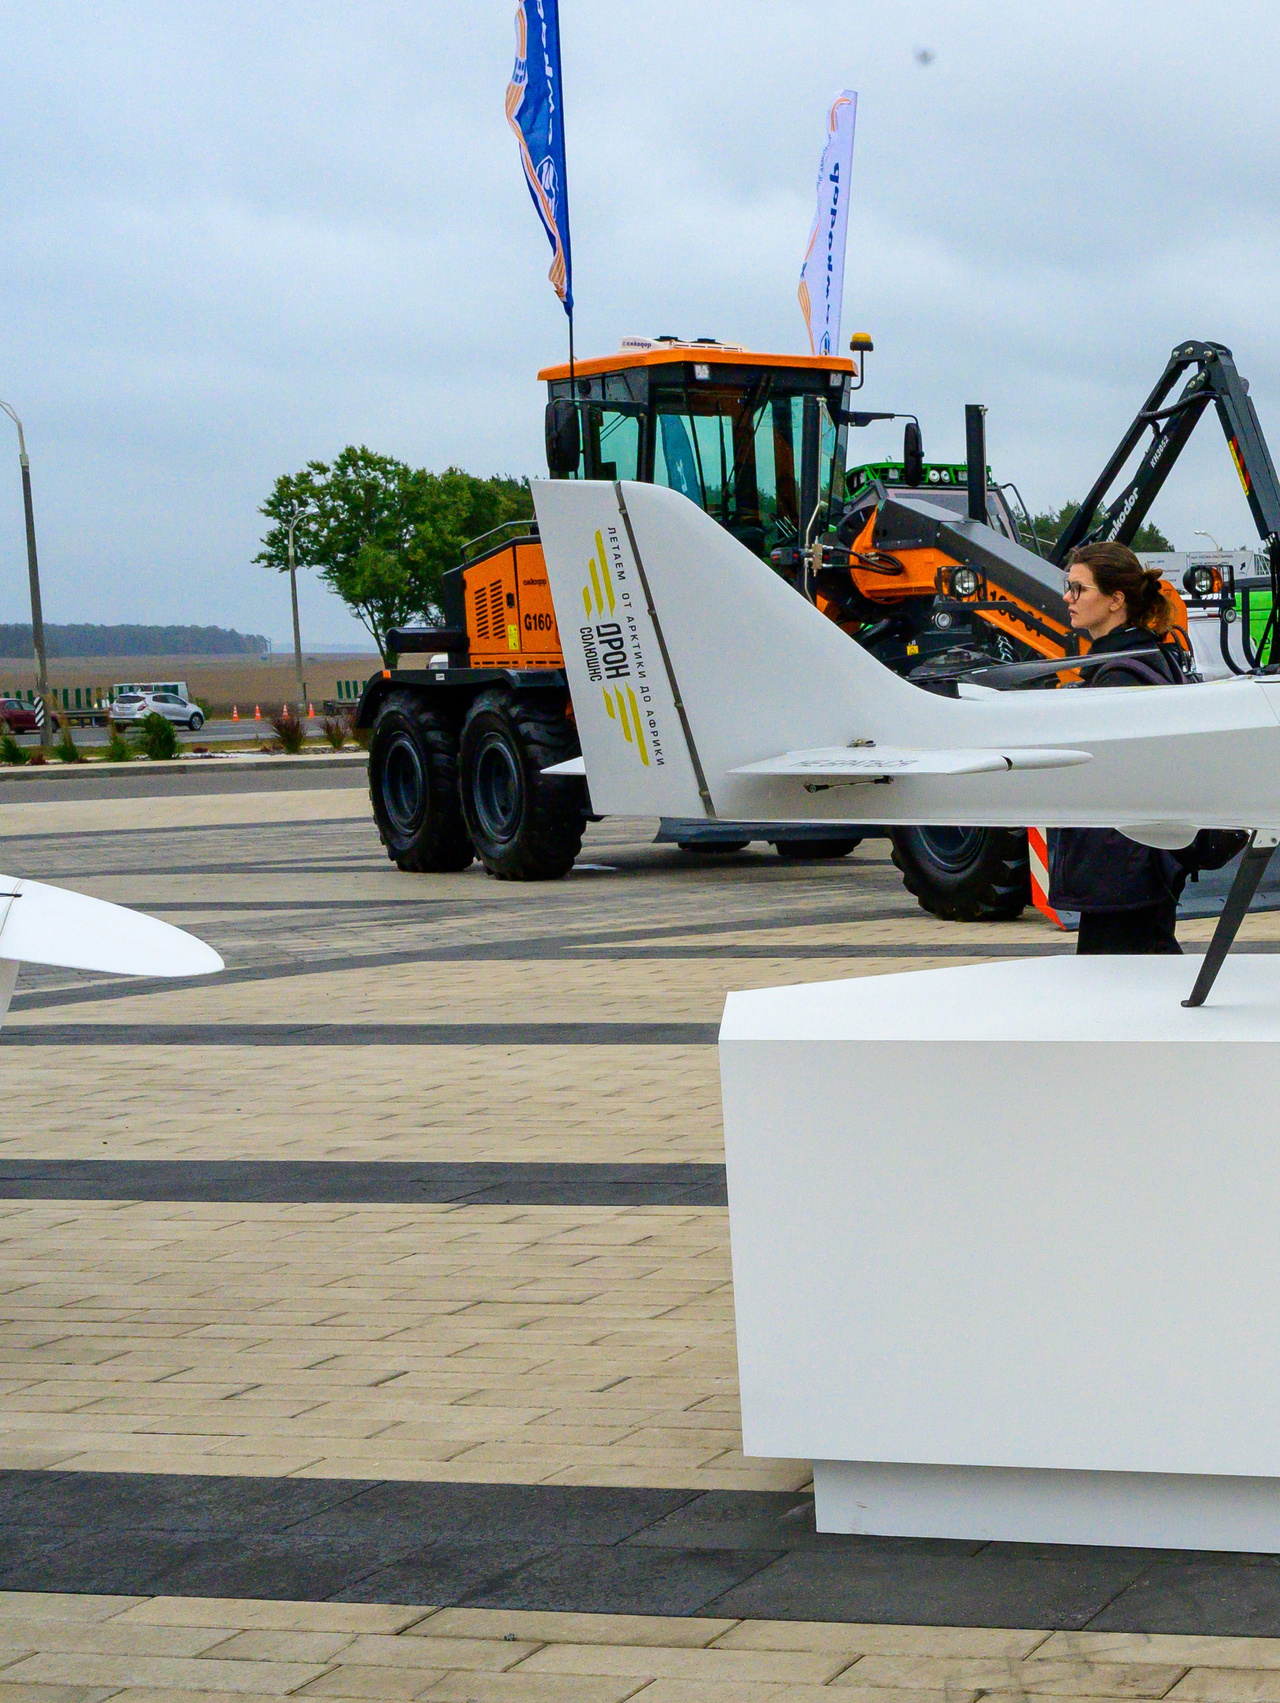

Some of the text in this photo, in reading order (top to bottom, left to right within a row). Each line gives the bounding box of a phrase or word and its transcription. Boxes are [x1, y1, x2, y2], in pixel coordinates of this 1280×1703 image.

[524, 613, 552, 631] G160
[607, 527, 665, 766] ЛЕТАЕМ ОТ АРКТИКИ ДО АФРИКИ
[579, 626, 603, 682] СОЛЮШНС
[595, 622, 631, 680] ДРОН
